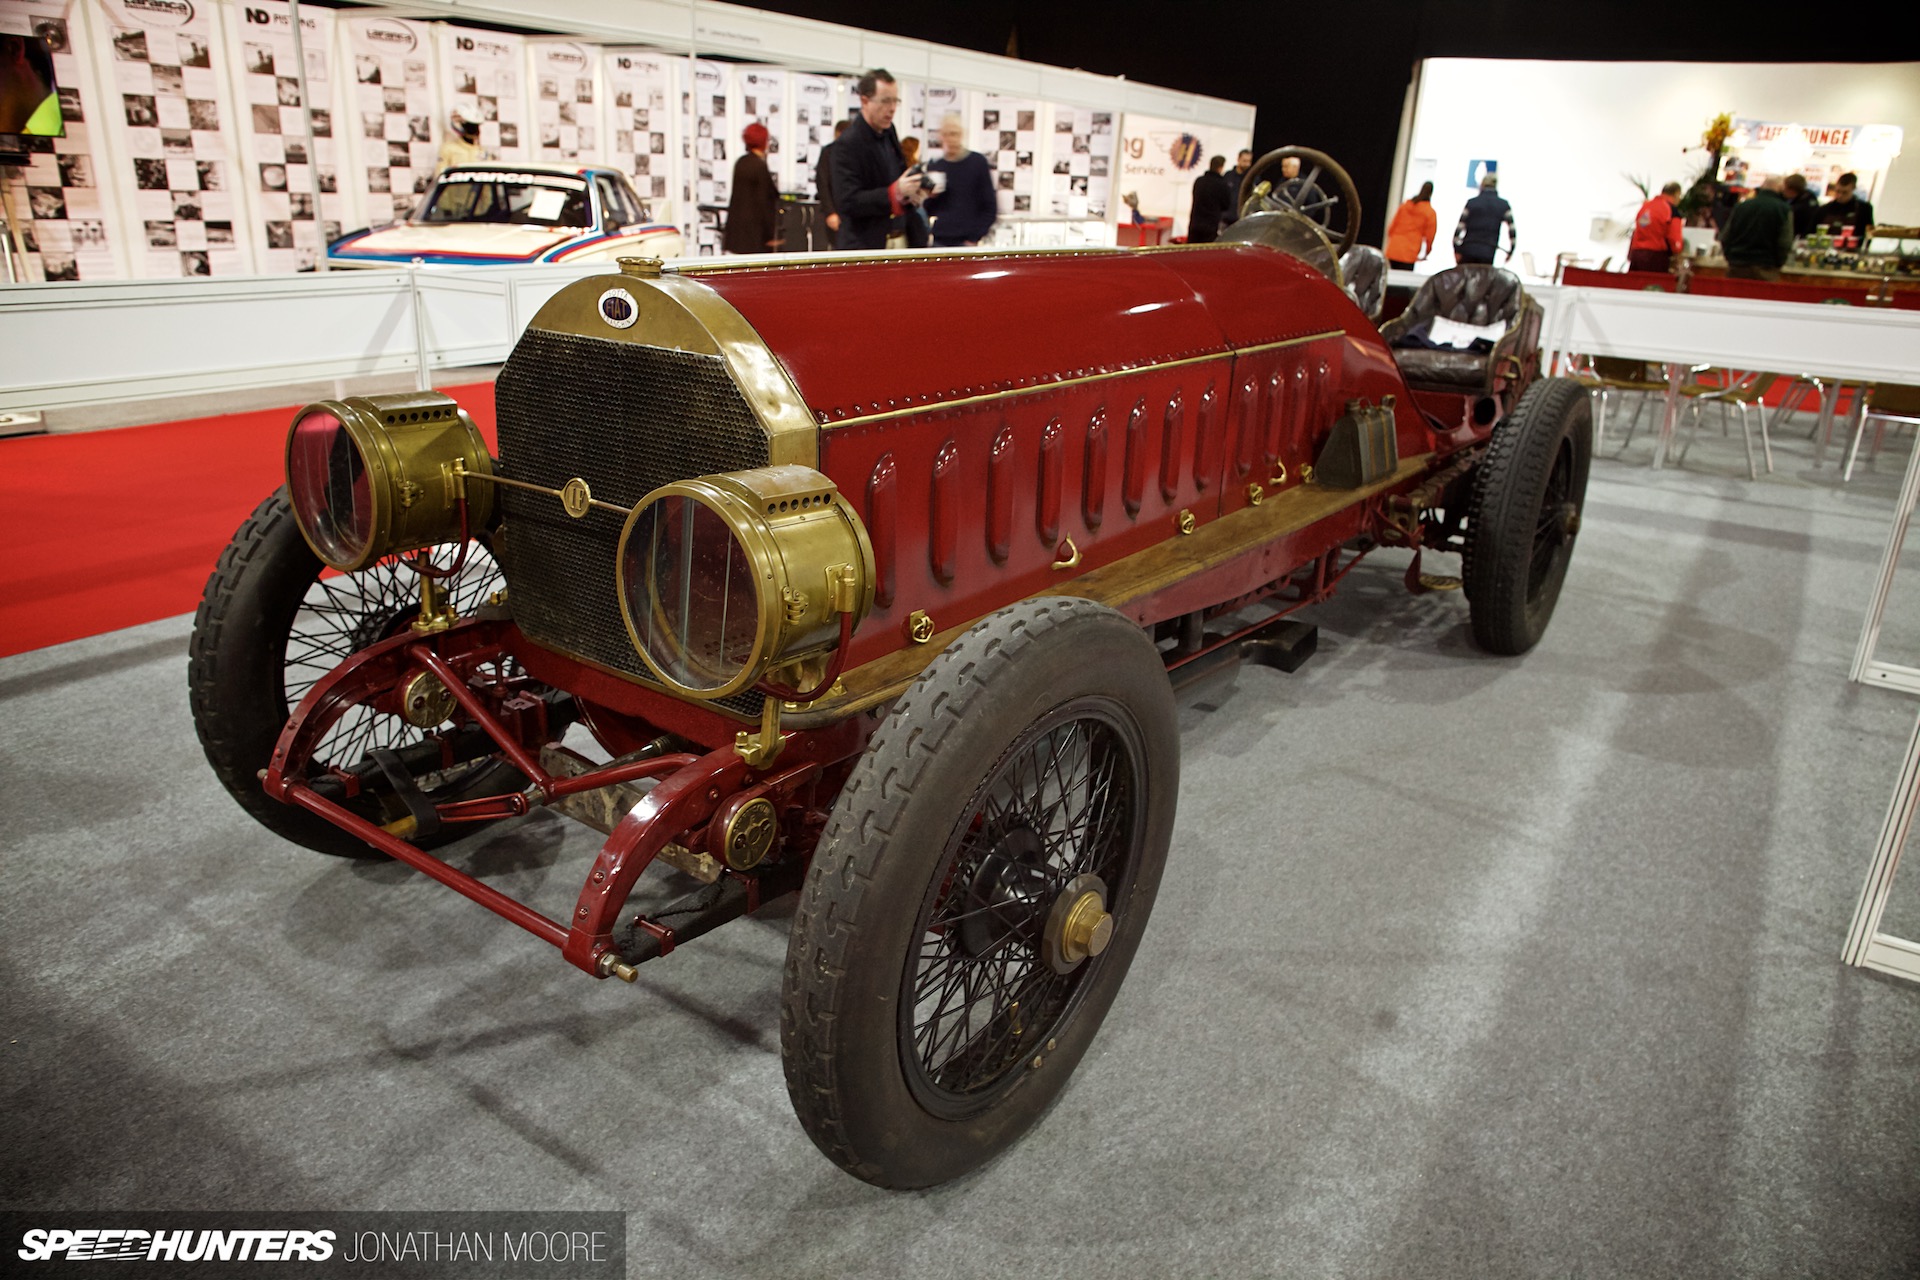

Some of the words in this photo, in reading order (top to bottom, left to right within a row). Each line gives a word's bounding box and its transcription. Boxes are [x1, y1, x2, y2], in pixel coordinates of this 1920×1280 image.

[245, 7, 270, 25] ND
[438, 172, 534, 184] Laranca
[606, 298, 627, 319] FIAT
